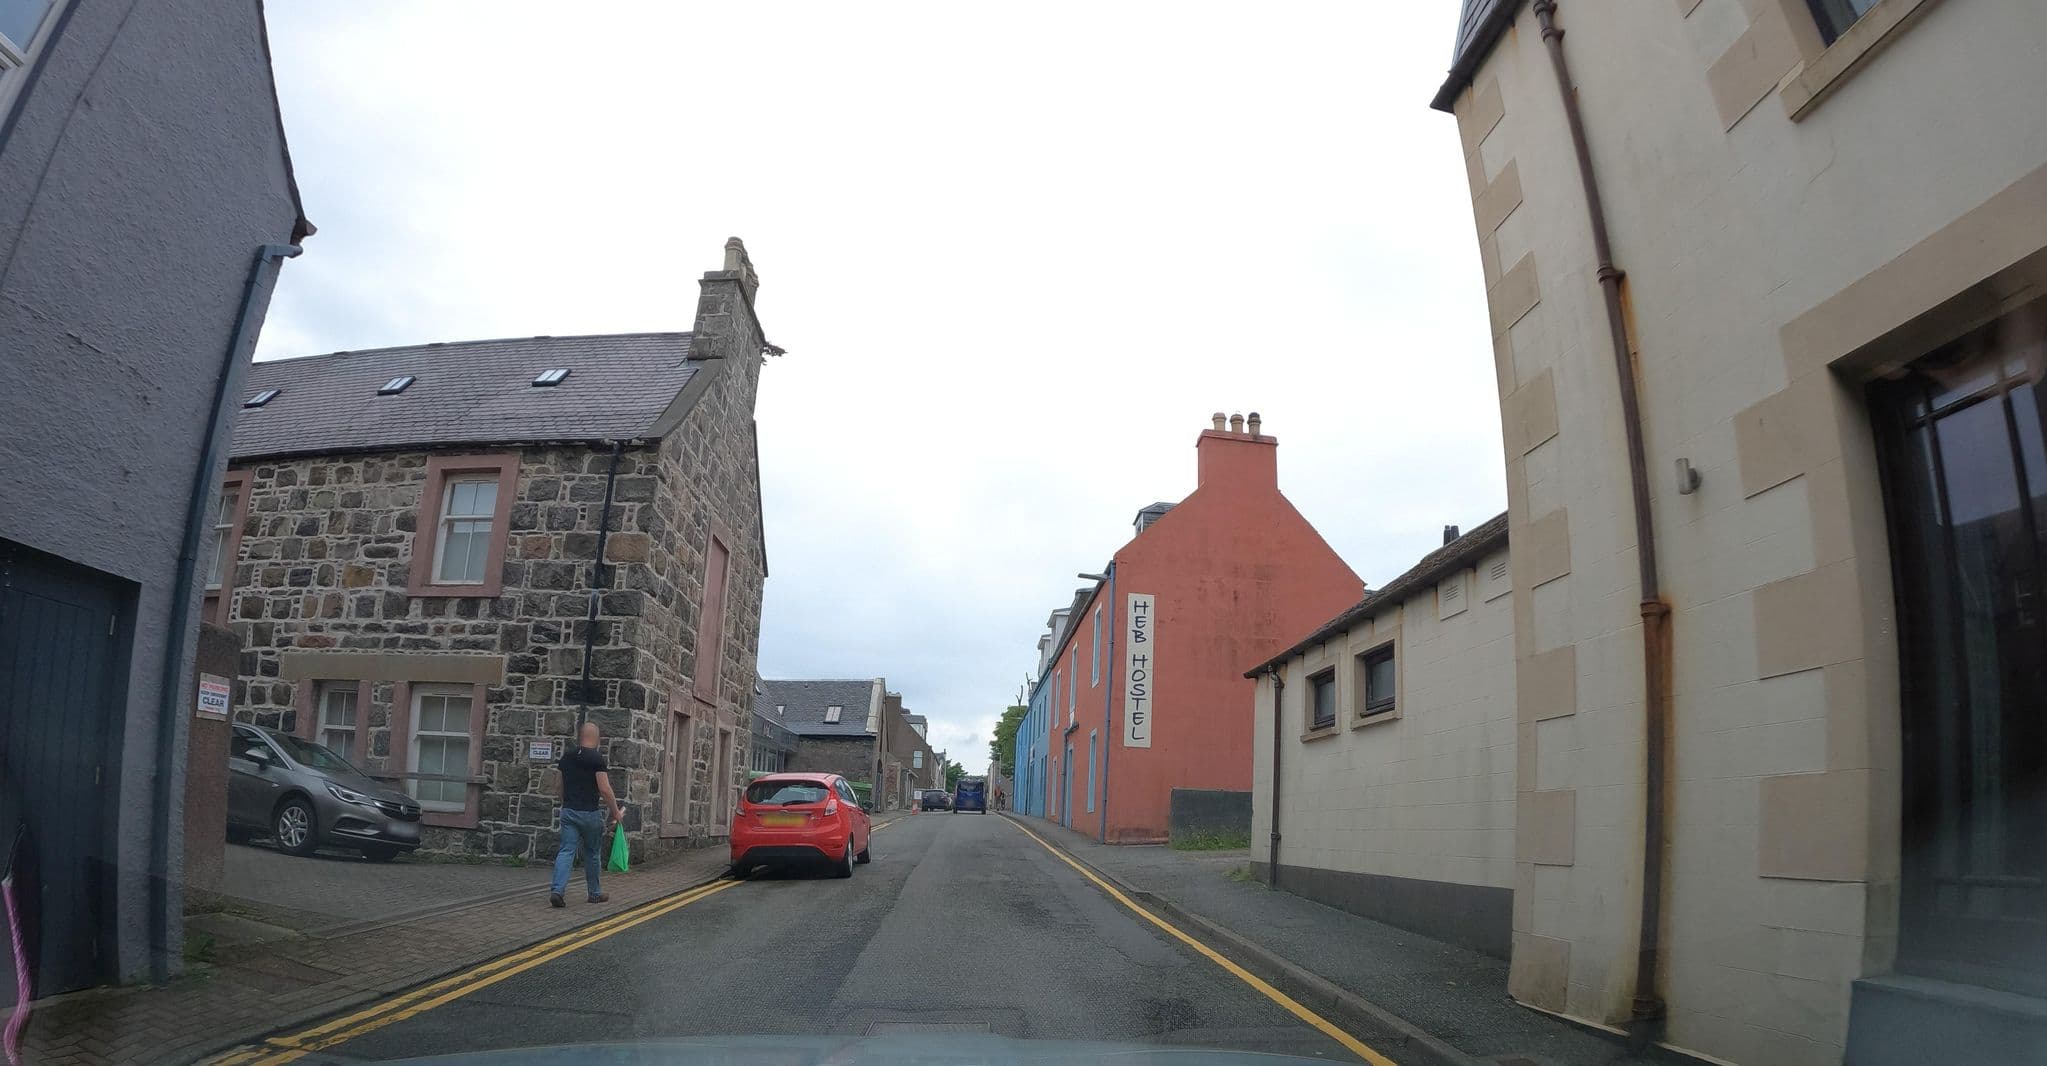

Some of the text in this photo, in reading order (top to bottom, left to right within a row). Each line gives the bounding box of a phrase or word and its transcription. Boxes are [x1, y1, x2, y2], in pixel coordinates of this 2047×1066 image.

[202, 697, 225, 707] CLEAR
[1130, 600, 1150, 740] HEB HOSTEL
